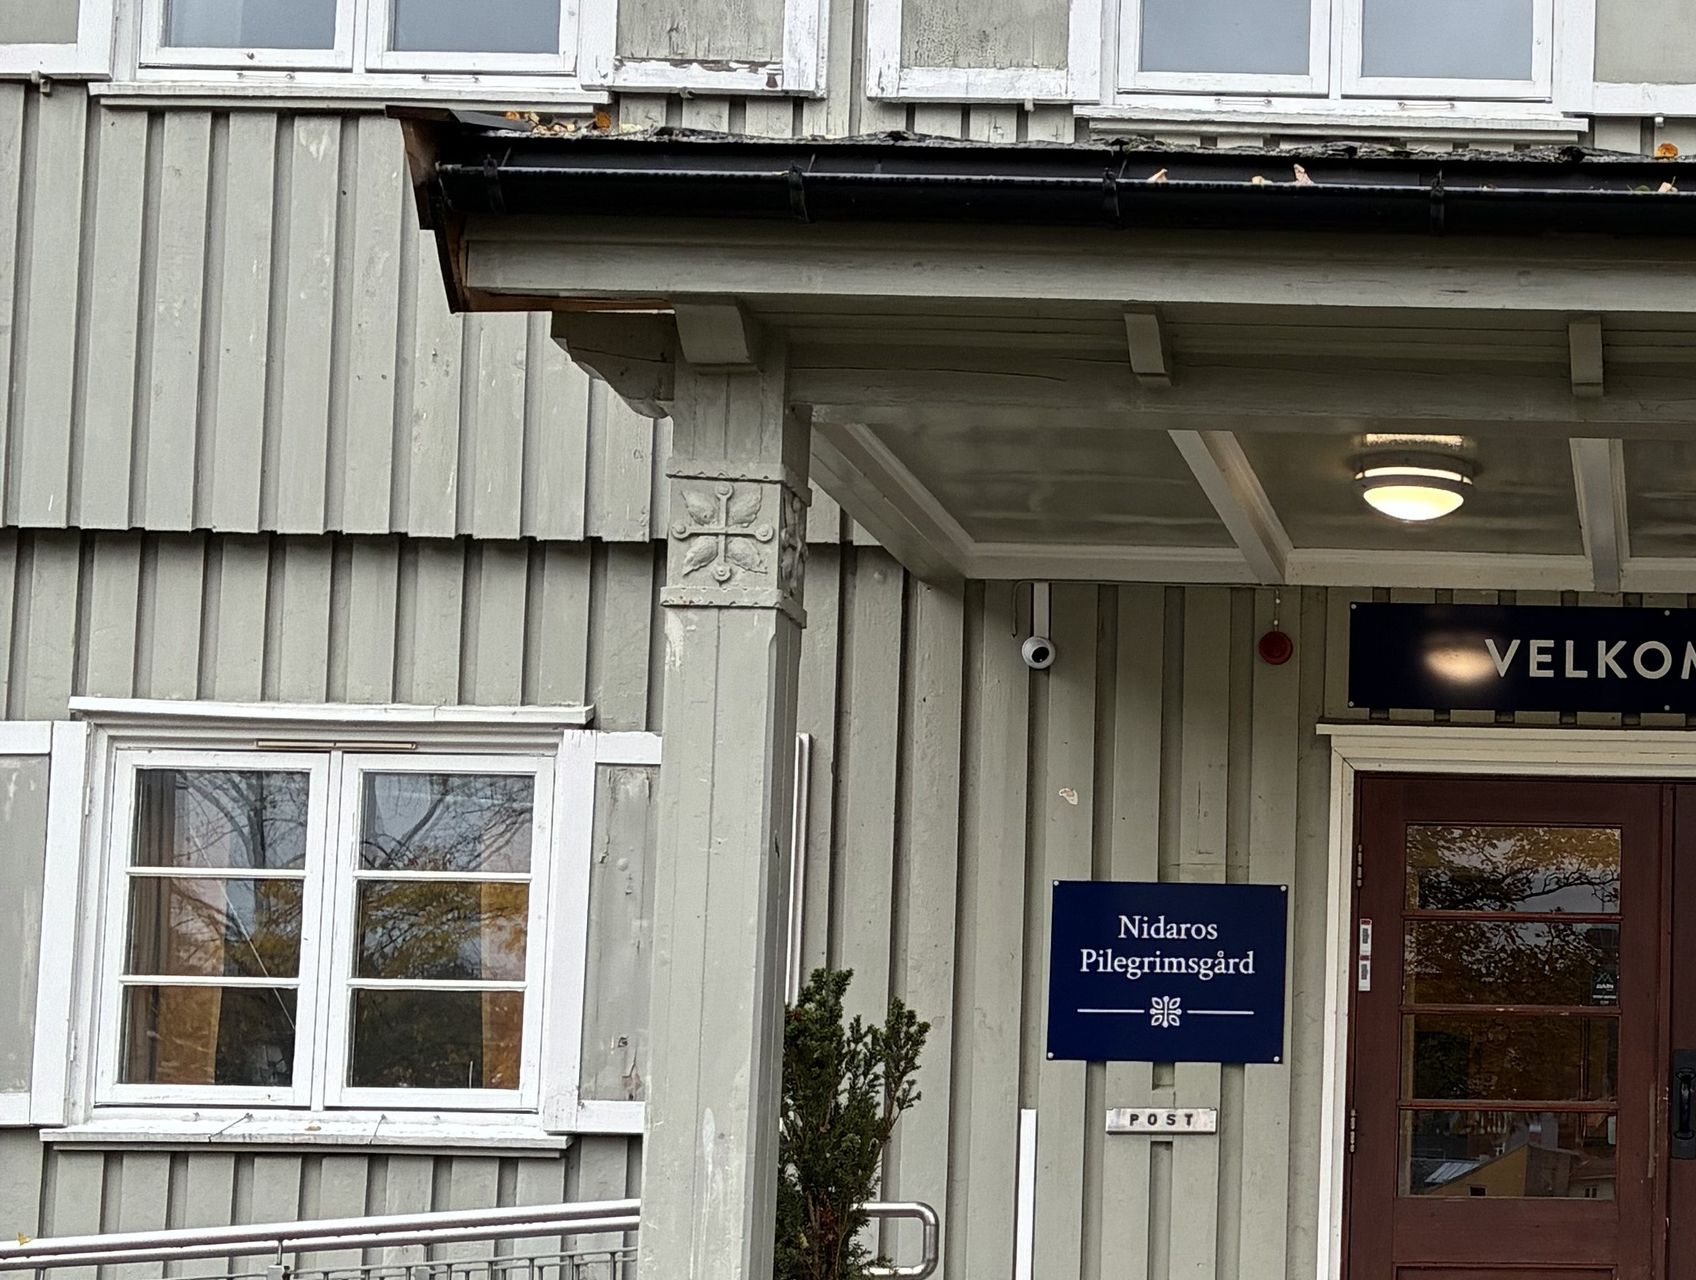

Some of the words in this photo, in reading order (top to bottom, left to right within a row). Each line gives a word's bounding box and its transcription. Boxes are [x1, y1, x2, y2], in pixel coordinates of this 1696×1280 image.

[1117, 914, 1218, 940] Nidaros
[1079, 948, 1256, 981] Pilegrimsgård
[1129, 1113, 1194, 1127] POST
